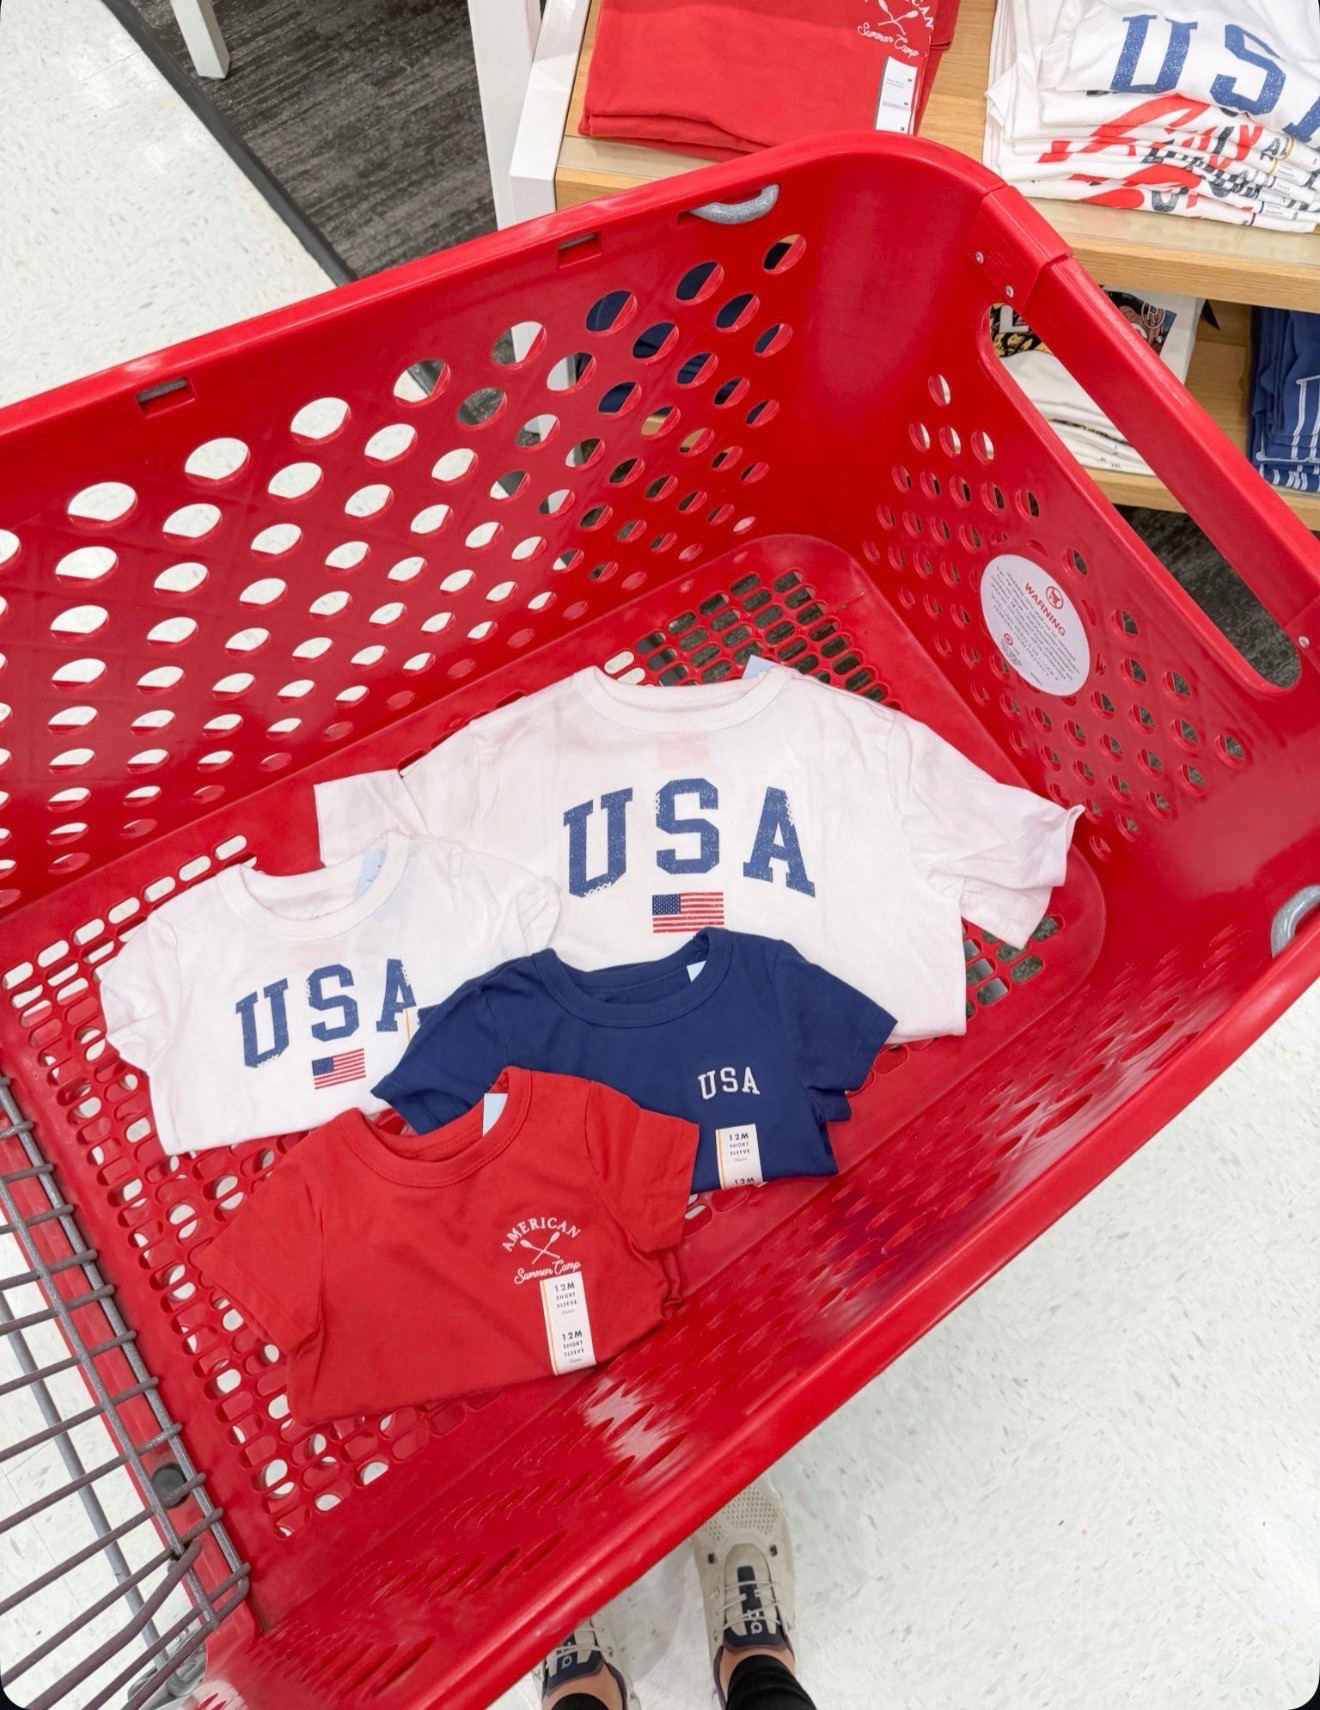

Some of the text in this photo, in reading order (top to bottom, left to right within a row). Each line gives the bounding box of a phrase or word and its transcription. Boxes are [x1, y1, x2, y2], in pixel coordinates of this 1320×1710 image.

[857, 22, 919, 58] Summer Camp
[1110, 14, 1320, 143] US
[1024, 582, 1066, 637] WARNING
[563, 778, 816, 898] USA
[235, 958, 420, 1068] USA
[698, 1066, 761, 1100] USA
[729, 1132, 749, 1141] 12M
[502, 1217, 581, 1253] AMERICAN
[514, 1259, 581, 1285] Summer Camp
[555, 1281, 575, 1292] 12M
[556, 1292, 576, 1300] SHORT
[557, 1299, 577, 1308] SLEEVE
[562, 1330, 583, 1341] 12M
[563, 1340, 583, 1349] SHORT
[564, 1348, 584, 1357] SLEEVE
